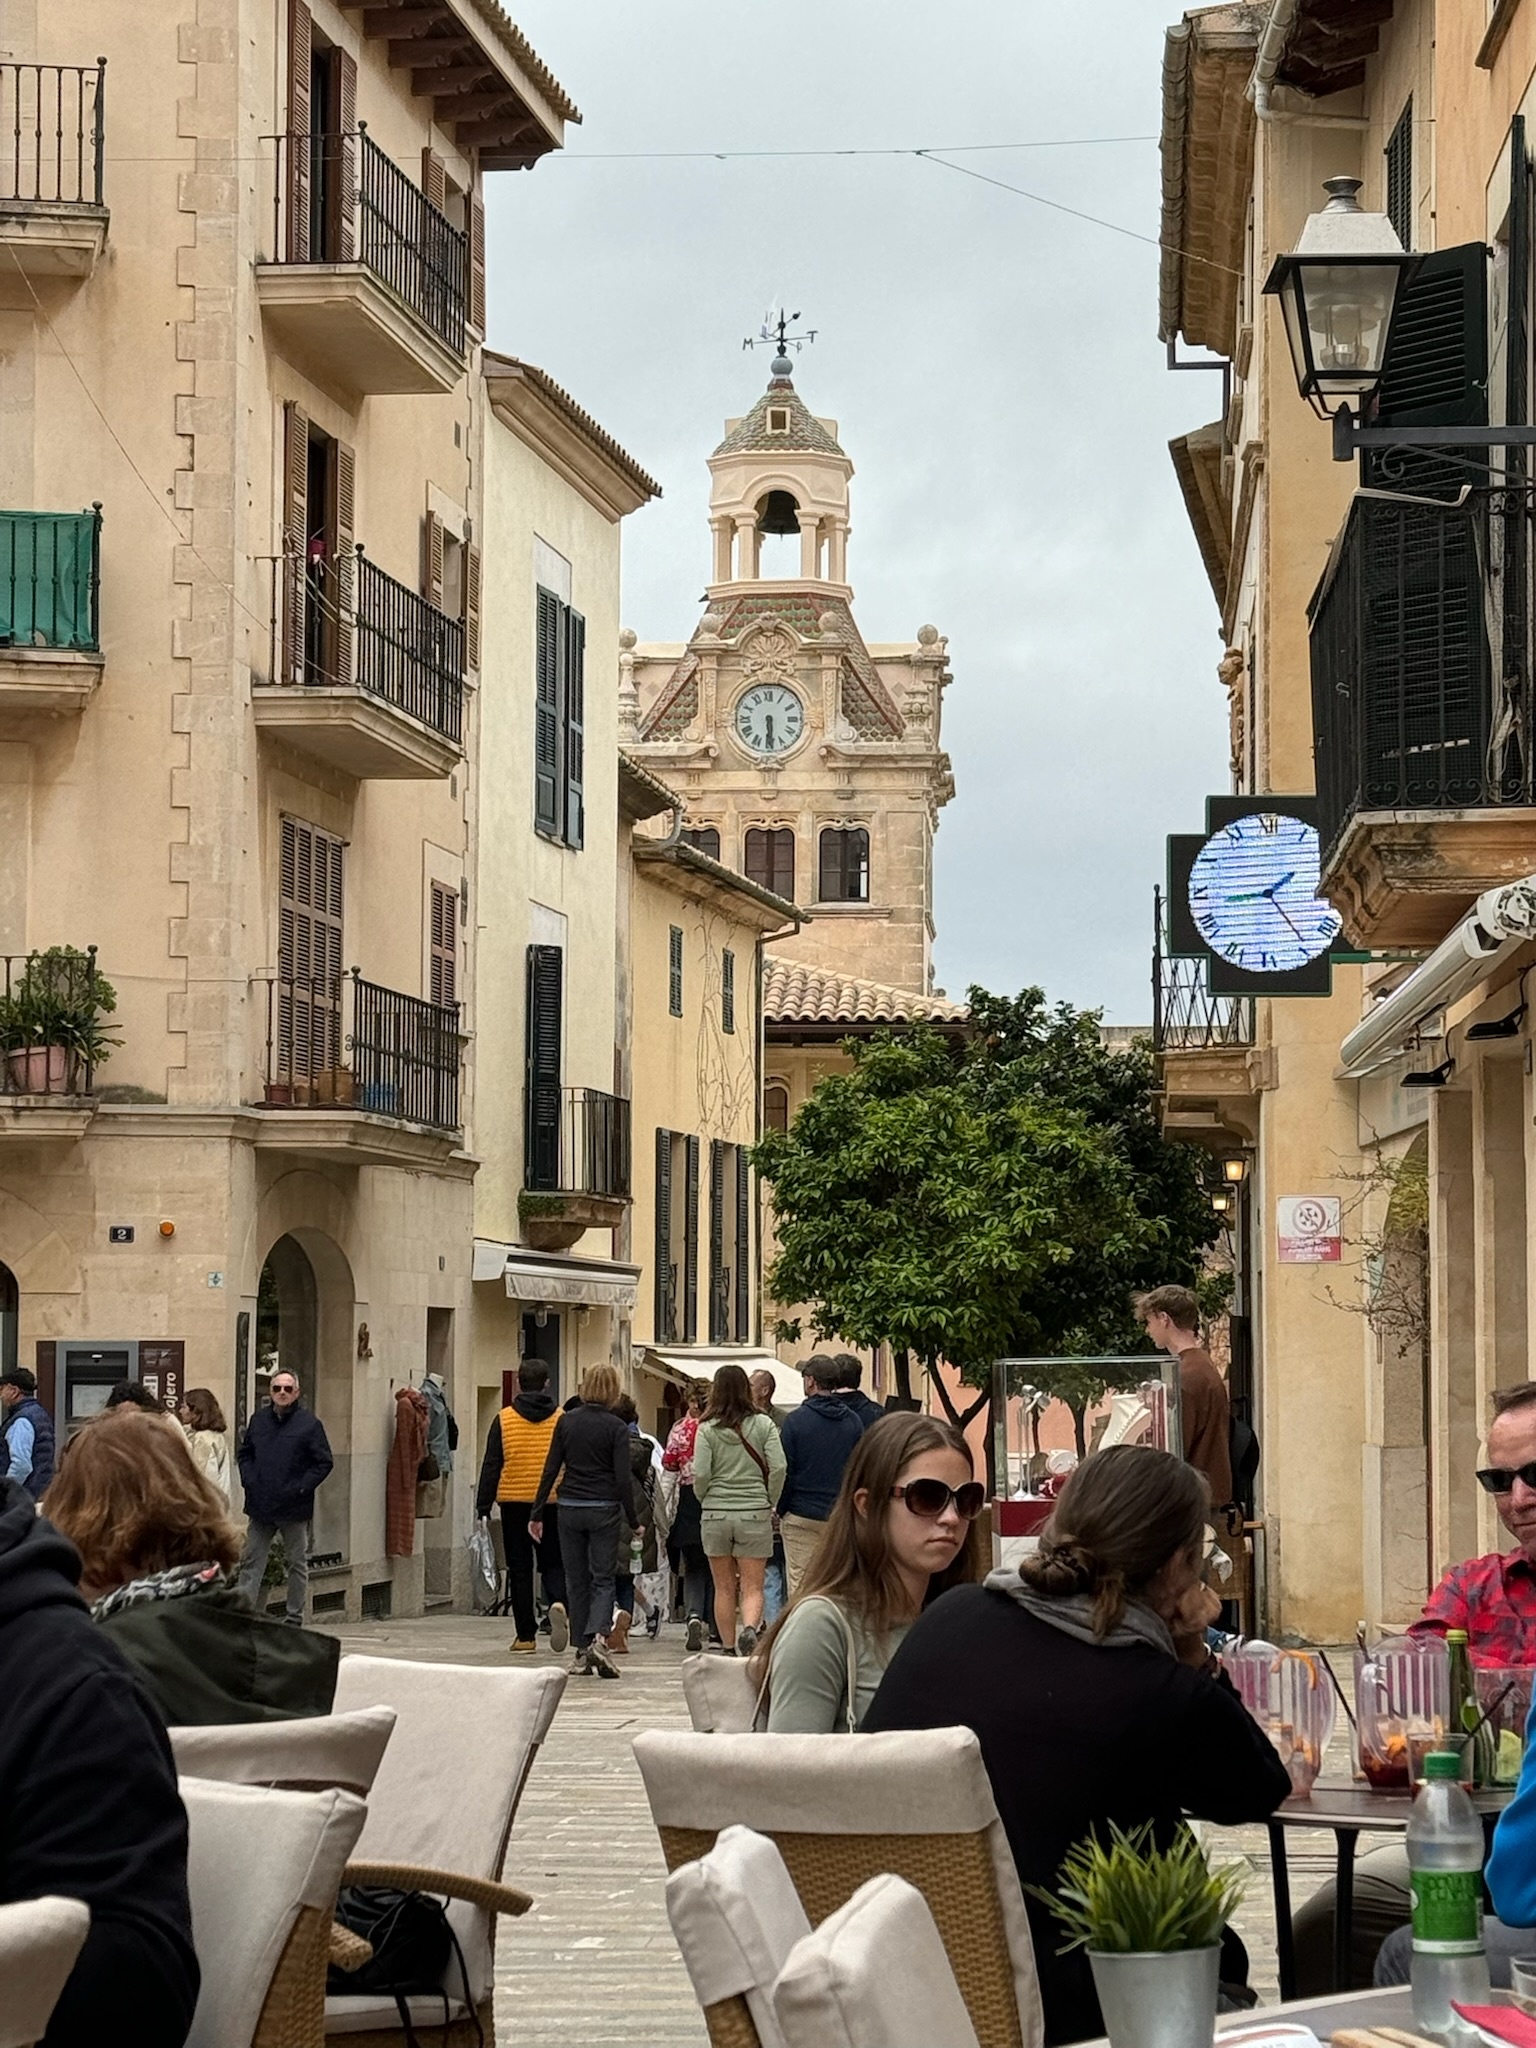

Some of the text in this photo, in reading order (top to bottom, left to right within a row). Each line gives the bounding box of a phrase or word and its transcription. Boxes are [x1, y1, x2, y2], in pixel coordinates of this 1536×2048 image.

[763, 690, 773, 702] XII
[117, 1228, 127, 1240] 2
[162, 1372, 178, 1408] ajero
